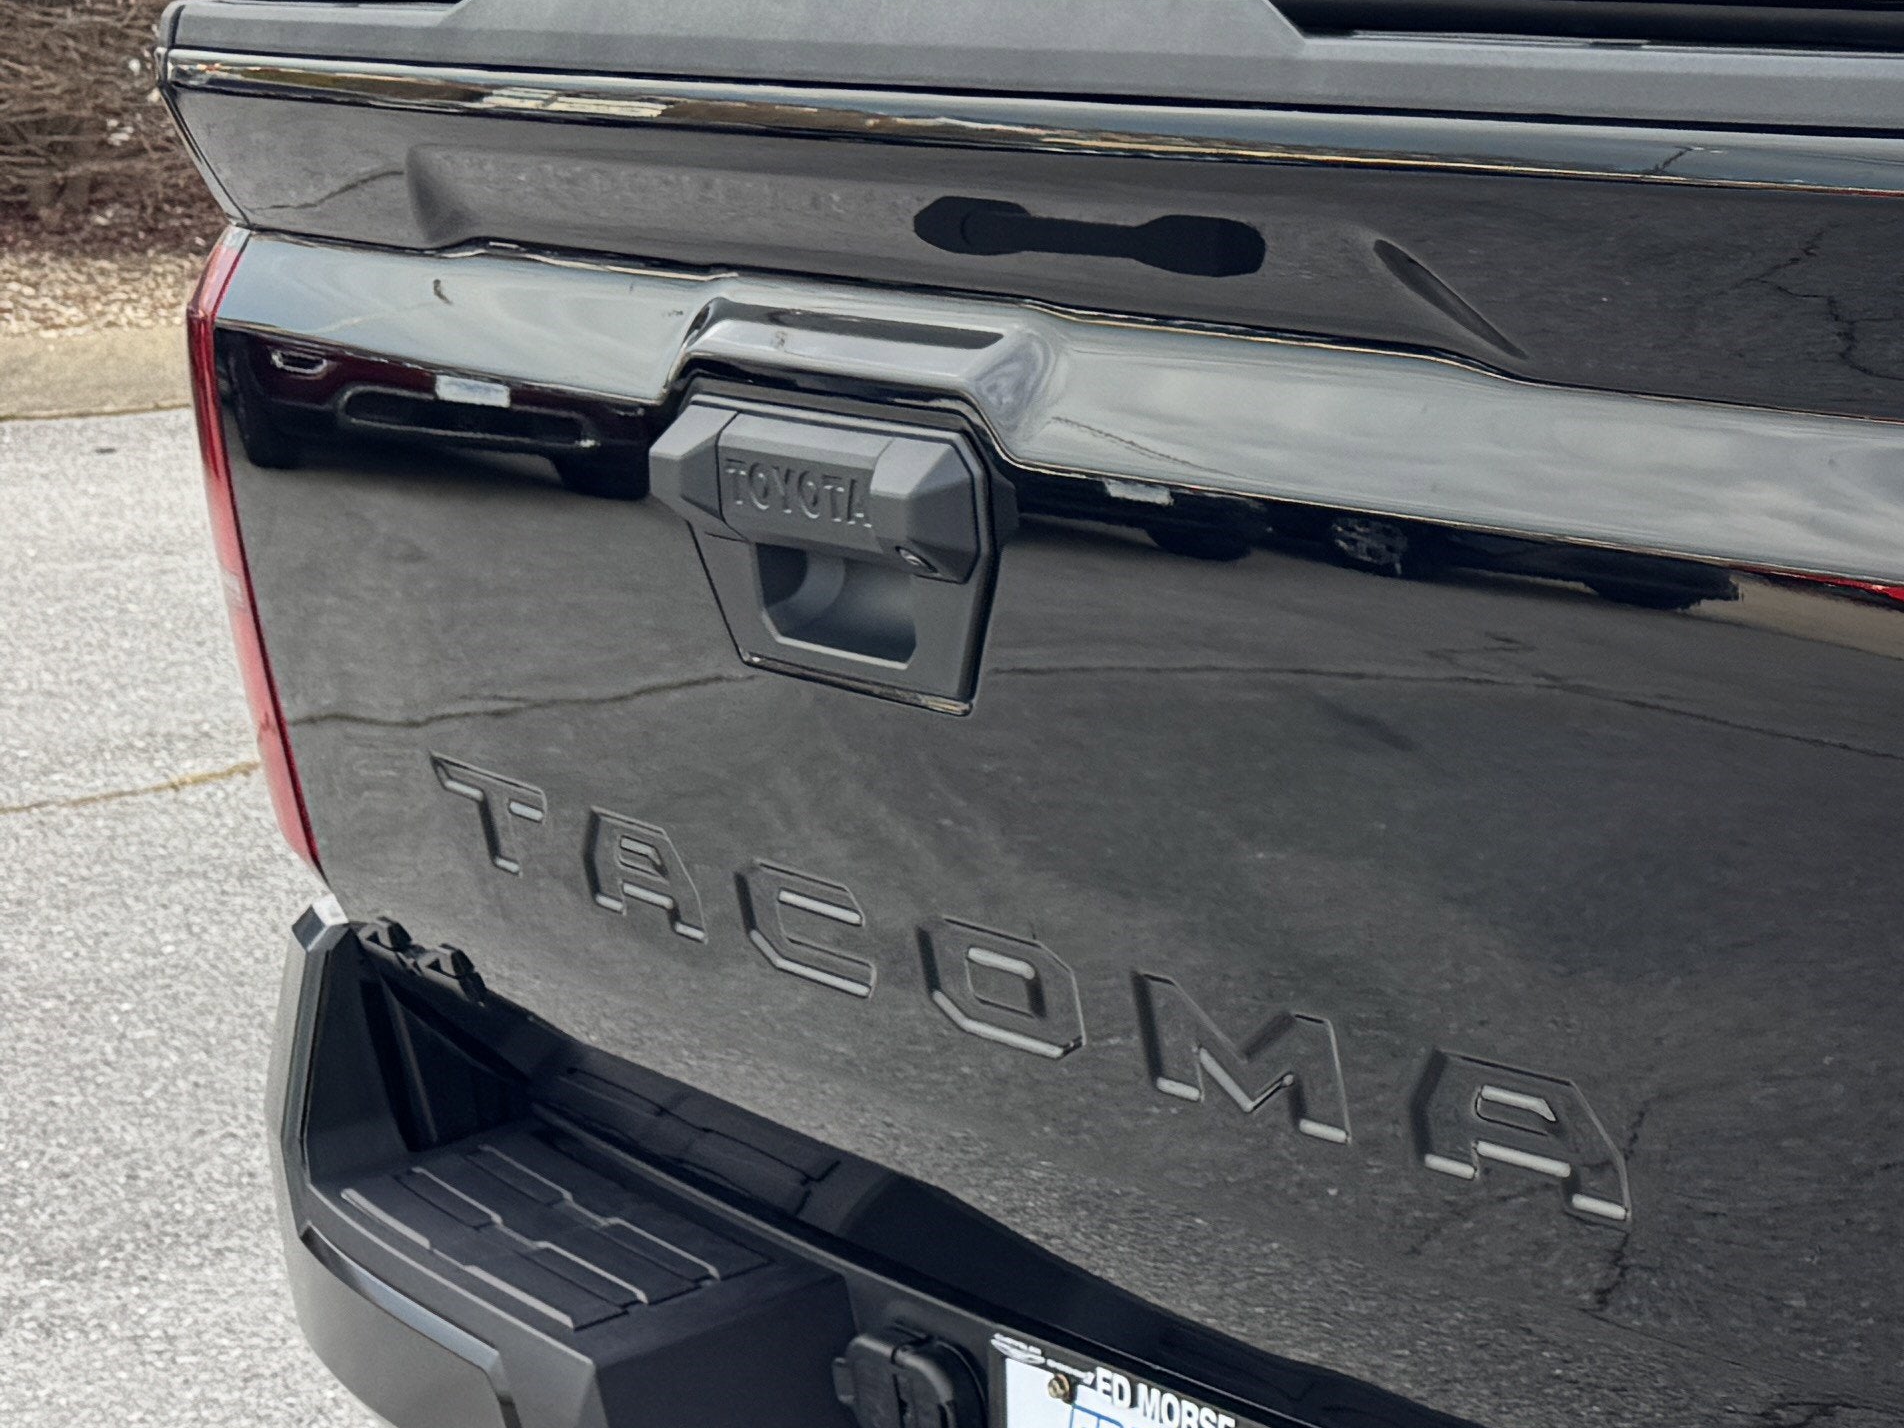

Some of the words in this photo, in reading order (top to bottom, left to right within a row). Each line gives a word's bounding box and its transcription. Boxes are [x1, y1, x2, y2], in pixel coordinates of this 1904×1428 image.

[724, 457, 873, 529] TOYOTA
[429, 752, 1632, 1222] TACOMA
[1095, 1367, 1132, 1409] ED
